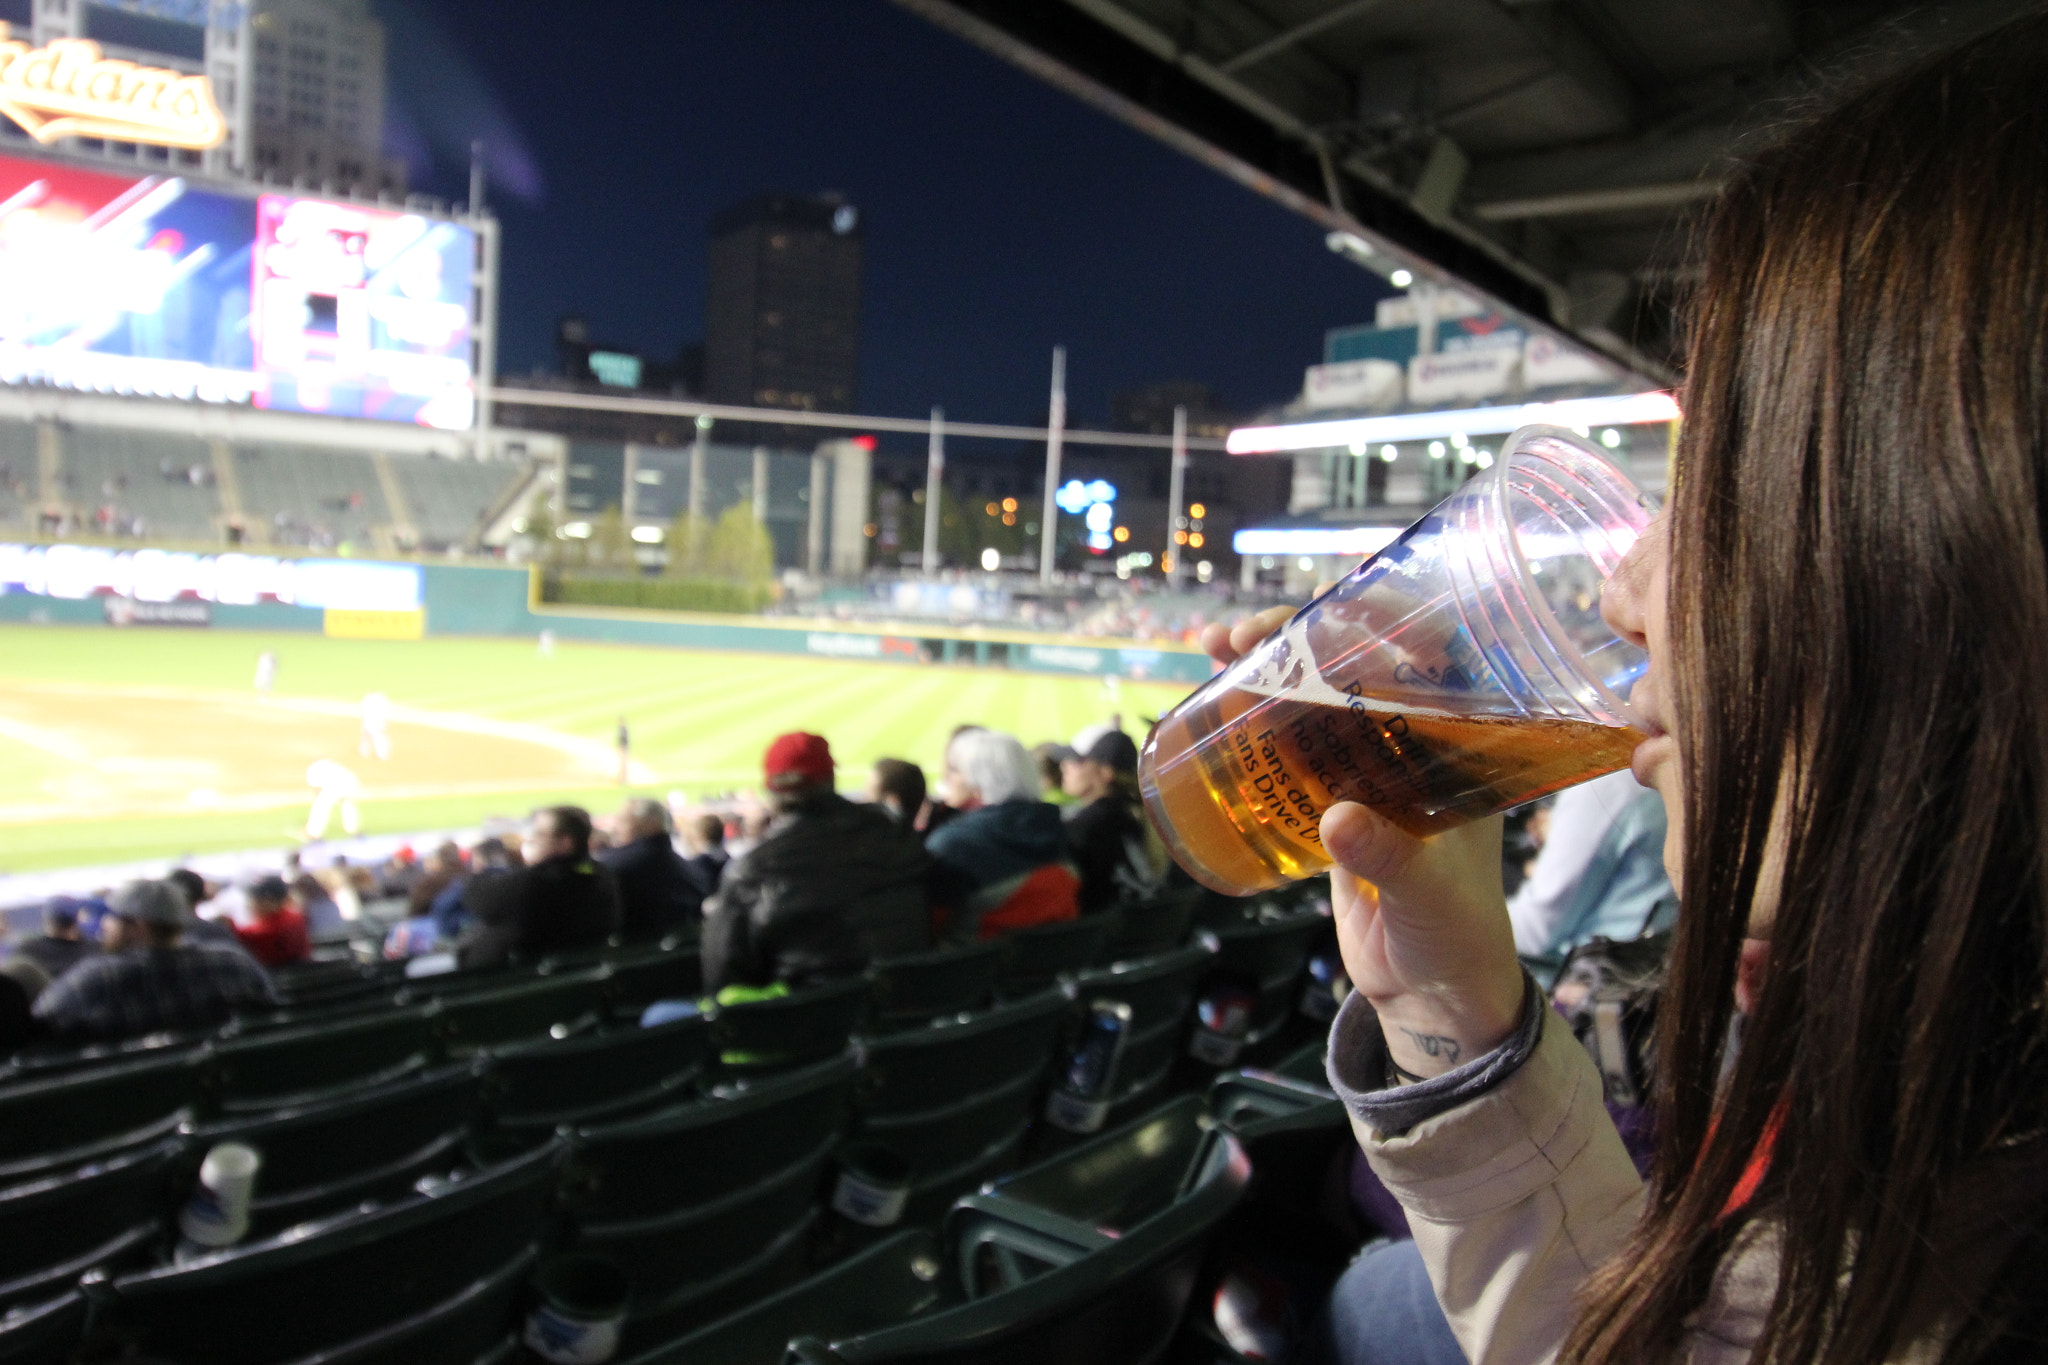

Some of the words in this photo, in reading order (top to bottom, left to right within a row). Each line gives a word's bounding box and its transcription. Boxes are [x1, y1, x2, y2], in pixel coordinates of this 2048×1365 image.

[1233, 717, 1260, 773] Fans
[1254, 773, 1300, 829] Drive
[1257, 728, 1291, 785] Fans
[1287, 788, 1320, 826] don
[1290, 719, 1313, 752] no
[1309, 756, 1348, 800] acci
